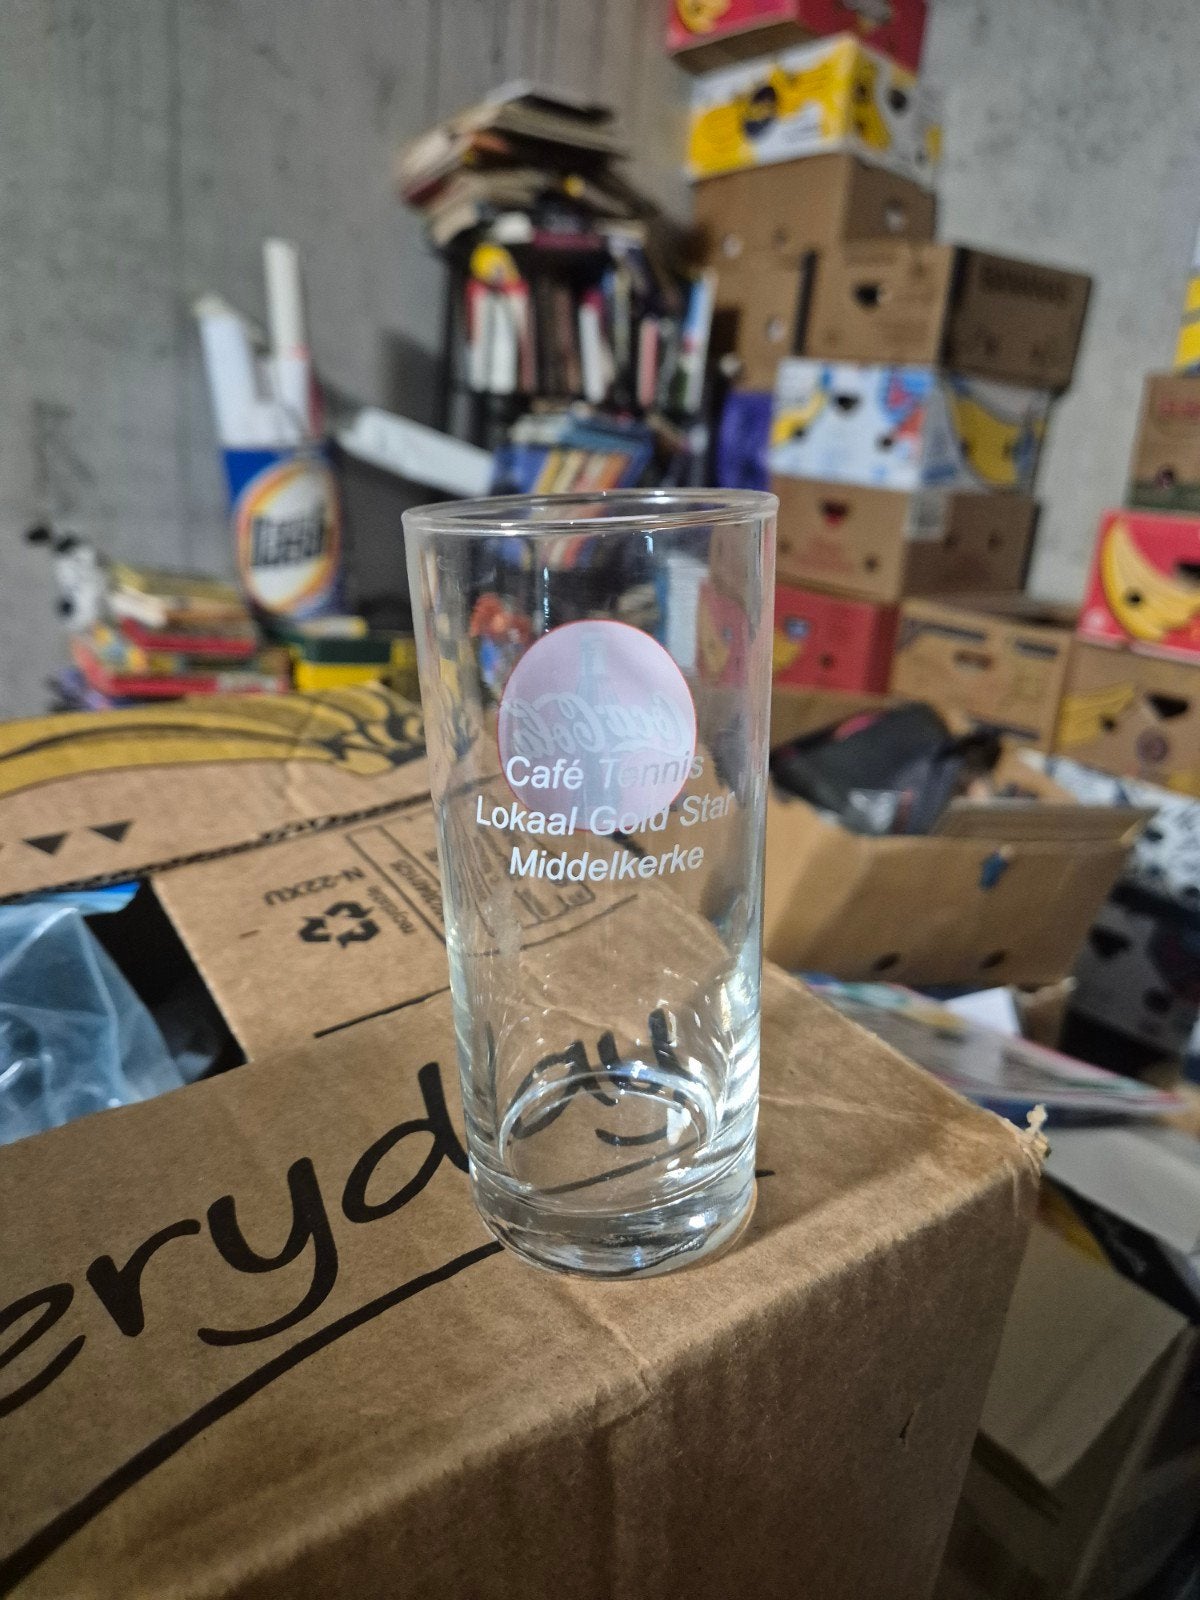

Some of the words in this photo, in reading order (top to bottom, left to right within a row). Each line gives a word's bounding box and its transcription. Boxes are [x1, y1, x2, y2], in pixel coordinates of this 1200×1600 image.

[506, 755, 585, 790] Café
[599, 751, 705, 789] Tennis
[476, 795, 578, 836] Lokaal
[590, 803, 671, 836] Gold
[679, 791, 737, 828] Star
[509, 843, 705, 882] Middelkerke
